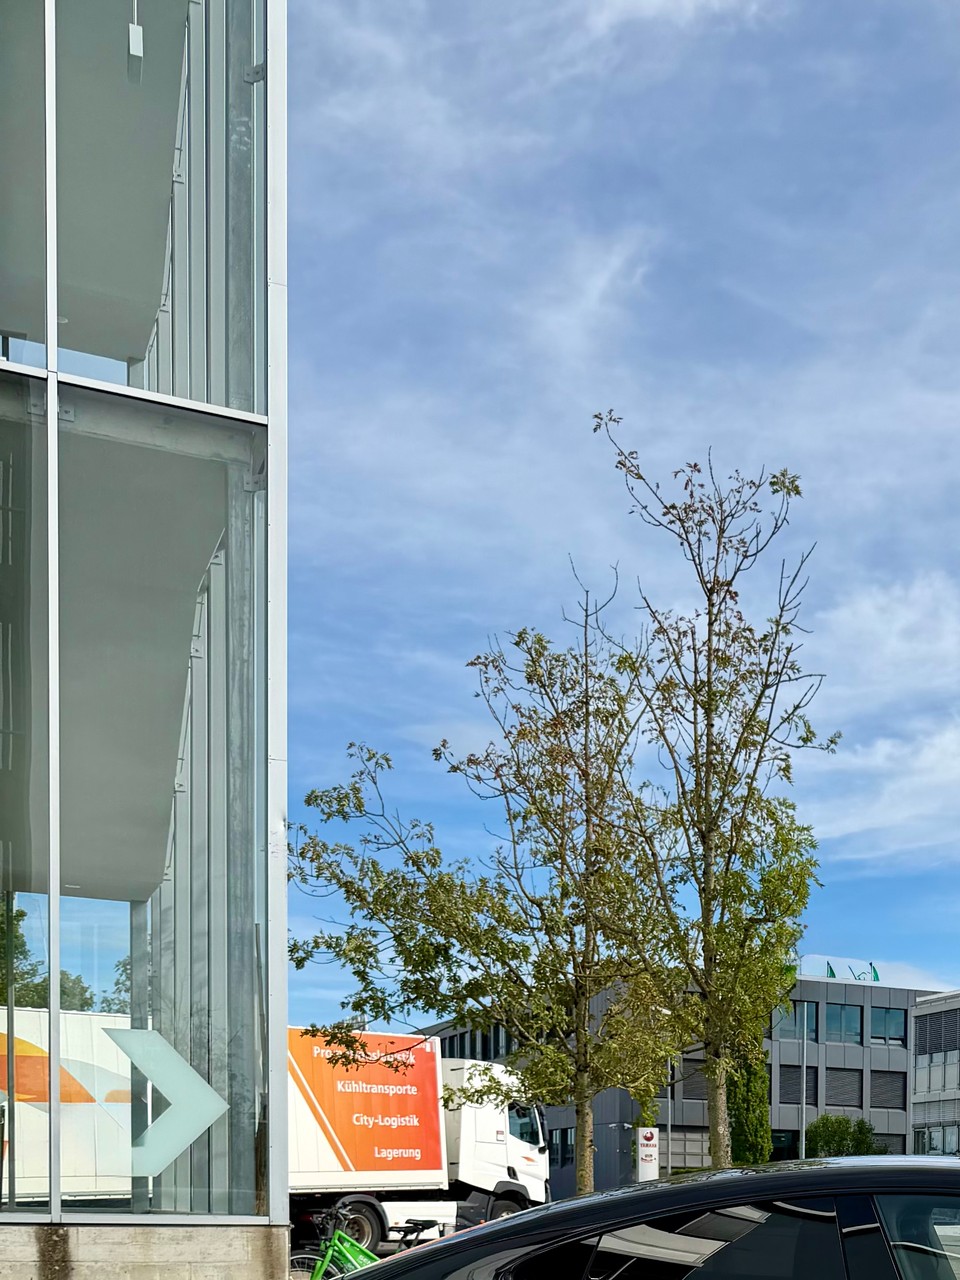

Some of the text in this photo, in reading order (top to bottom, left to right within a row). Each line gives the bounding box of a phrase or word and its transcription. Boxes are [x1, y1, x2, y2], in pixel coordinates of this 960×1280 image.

[337, 1080, 418, 1096] Kühltransporte
[353, 1113, 419, 1128] City-Logistik
[374, 1147, 421, 1160] Lagerung
